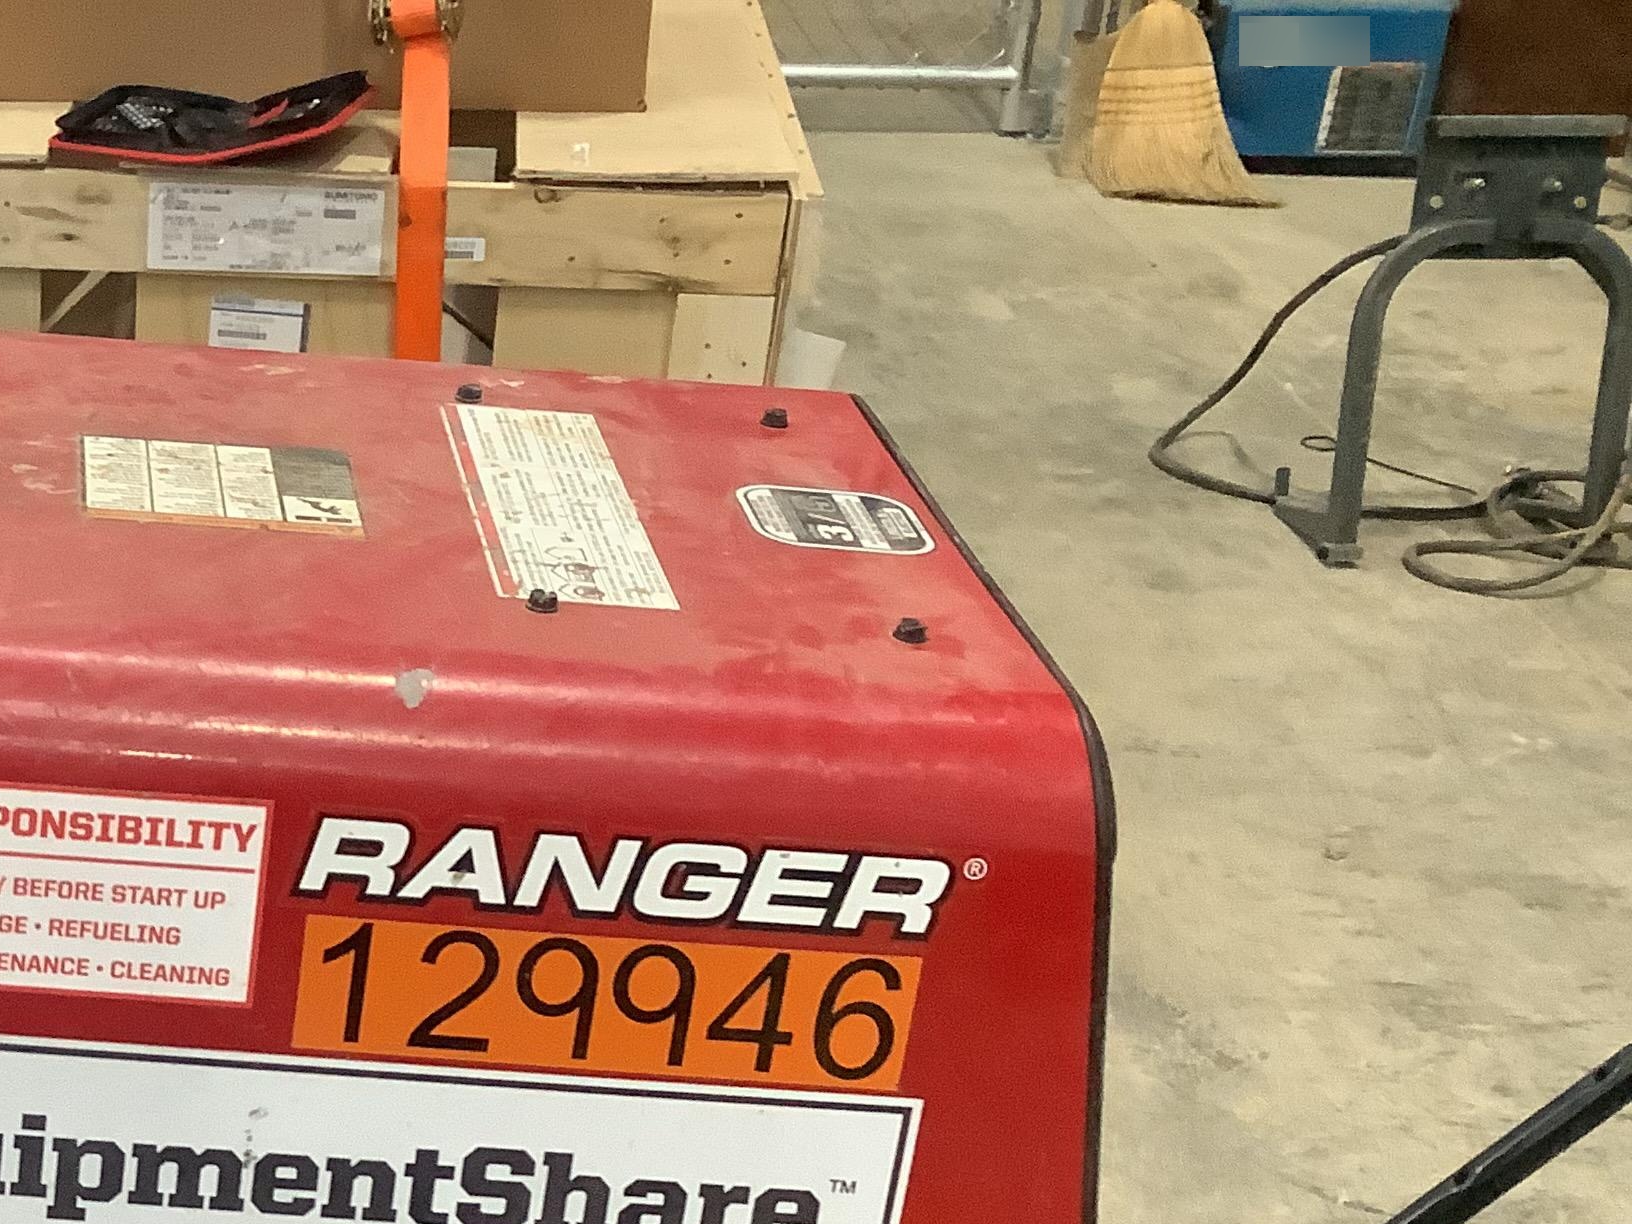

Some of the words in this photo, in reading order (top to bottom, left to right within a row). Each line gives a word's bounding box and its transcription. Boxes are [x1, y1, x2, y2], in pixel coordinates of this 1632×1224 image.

[12, 877, 104, 902] BEFORE
[111, 884, 188, 907] START
[194, 889, 227, 910] UP
[293, 815, 954, 940] RANGER
[47, 918, 182, 946] REFUELING
[109, 960, 231, 988] CLEANING
[320, 919, 904, 1082] 129946
